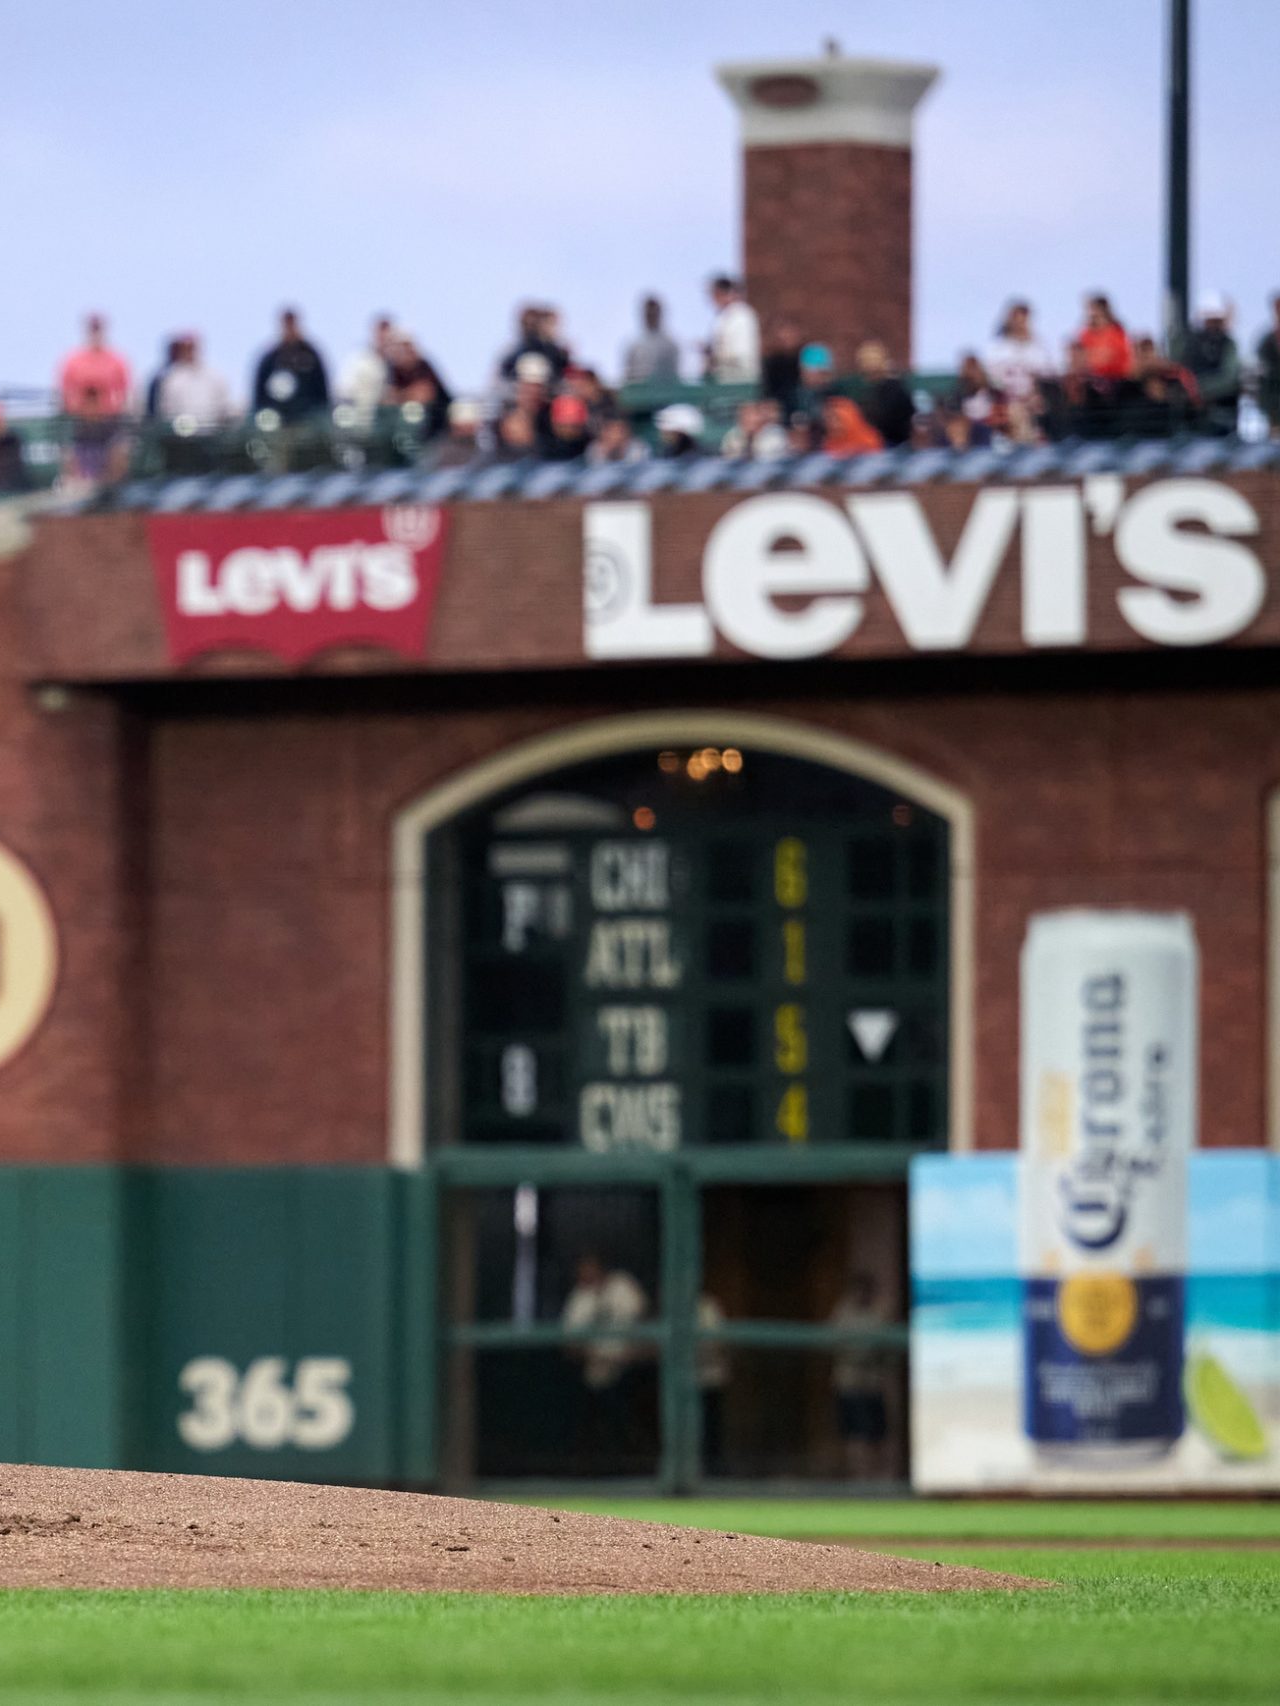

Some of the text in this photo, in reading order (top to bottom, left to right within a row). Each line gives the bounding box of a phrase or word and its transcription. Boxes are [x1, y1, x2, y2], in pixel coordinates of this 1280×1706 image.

[585, 919, 806, 988] ATL 1
[775, 1003, 807, 1075] 5
[776, 1083, 808, 1145] 4
[177, 1355, 355, 1450] 365
